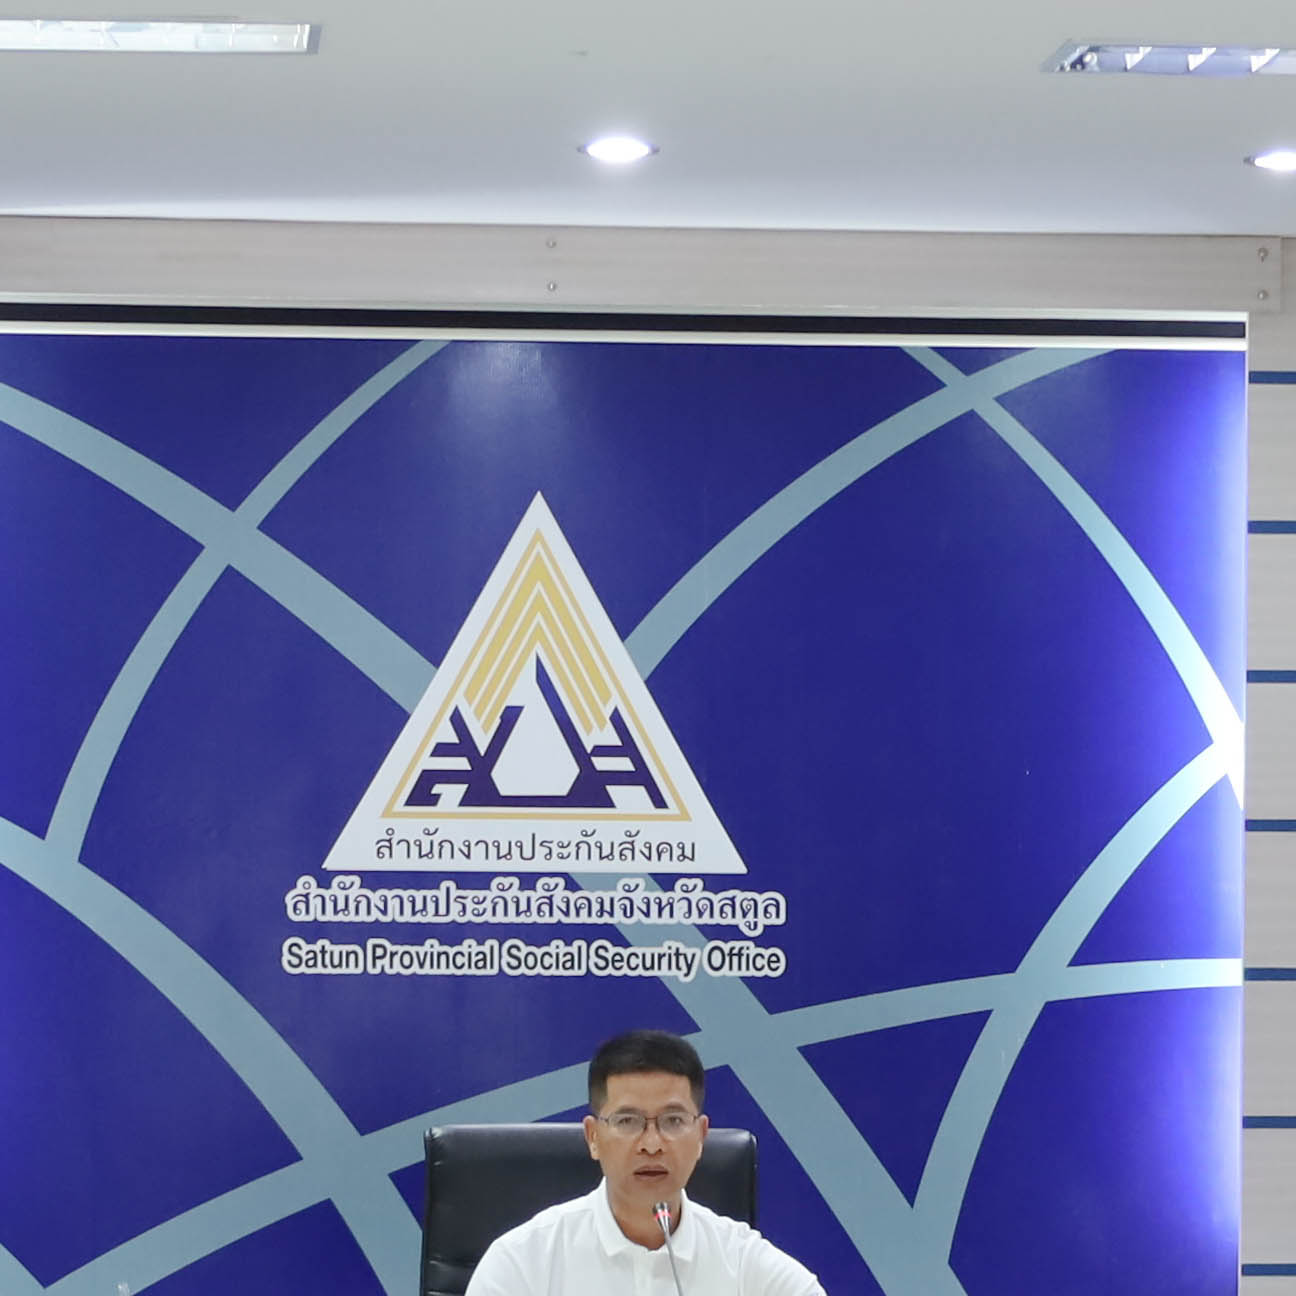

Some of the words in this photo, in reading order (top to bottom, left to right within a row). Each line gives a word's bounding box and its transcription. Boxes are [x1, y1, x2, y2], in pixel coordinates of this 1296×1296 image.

[375, 828, 696, 863] สำนักงานประกันสังคม
[291, 881, 781, 932] สำนักงานประกันสังคมจังหวัดสตูล
[286, 942, 359, 970] Satun
[372, 943, 495, 970] Provincial
[506, 944, 582, 972] Social
[593, 945, 697, 978] Security
[707, 945, 782, 973] Office
